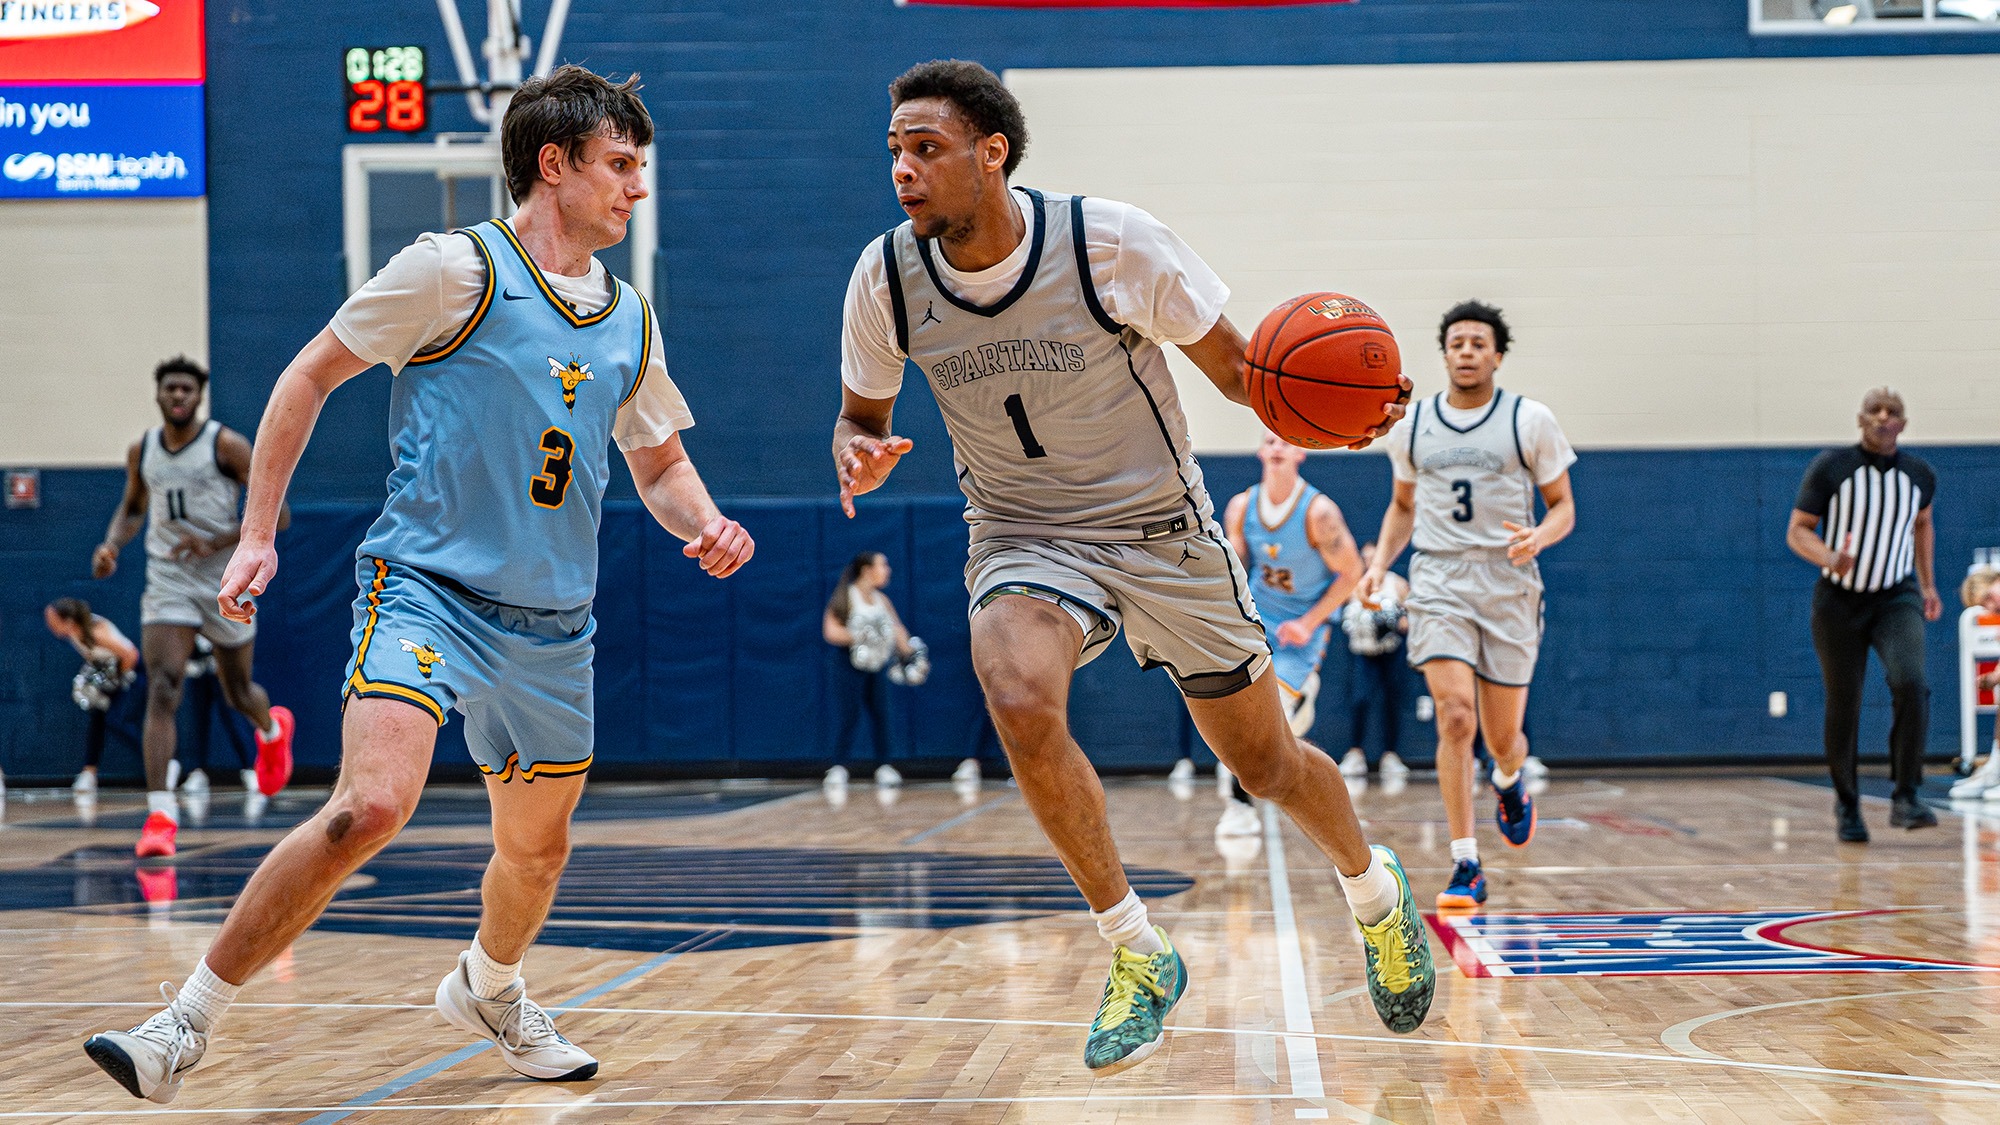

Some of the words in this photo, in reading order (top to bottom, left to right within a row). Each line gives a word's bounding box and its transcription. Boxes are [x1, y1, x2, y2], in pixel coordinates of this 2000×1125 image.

[0, 1, 120, 21] FINGERS
[30, 103, 91, 136] you
[349, 80, 424, 133] 28
[932, 339, 1086, 391] SPARTANS
[1003, 393, 1048, 459] 1
[528, 425, 576, 511] 3
[166, 488, 187, 520] 11
[1451, 479, 1473, 522] 3
[1174, 521, 1183, 530] M
[1262, 564, 1294, 594] 22
